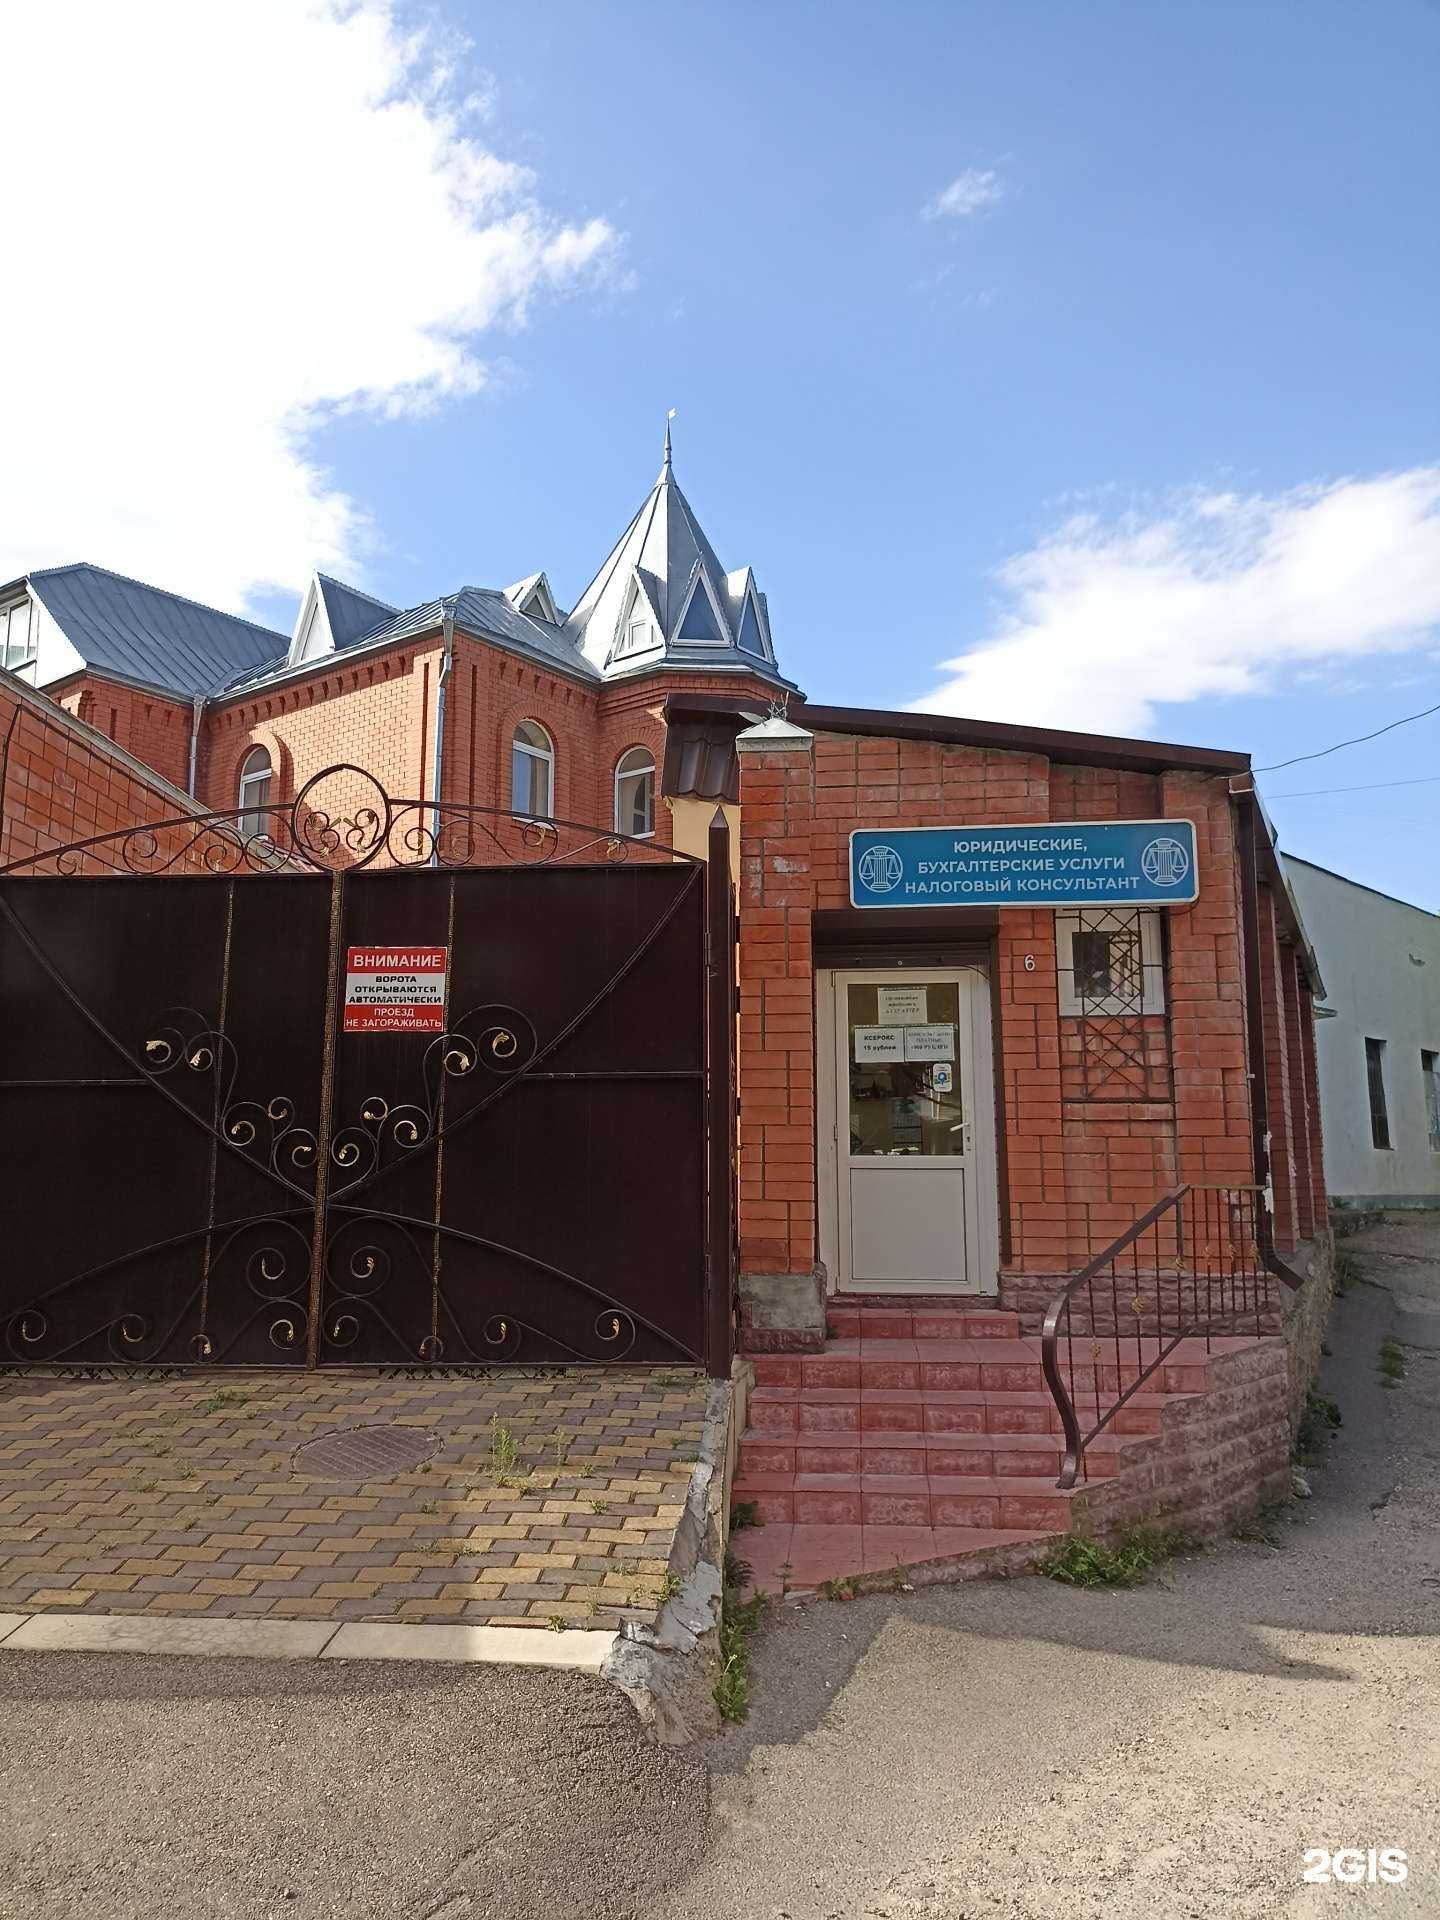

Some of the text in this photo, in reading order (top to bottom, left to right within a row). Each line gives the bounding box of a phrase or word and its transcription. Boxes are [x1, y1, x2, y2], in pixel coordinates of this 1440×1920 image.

[953, 838, 1088, 854] ЮРИДИЧЕСКИЕ,
[917, 857, 1126, 875] БУХГАЛТЕРСКИЕ УСЛУГИ
[905, 876, 1140, 894] НАЛОГОВЫЙ КОНСУЛЬТАНТ
[353, 954, 442, 967] ВНИМАНИЕ
[1024, 954, 1035, 971] 6
[375, 975, 417, 983] ВОРОТА
[349, 996, 442, 1004] АВТОМАТИЧЕСКИ
[374, 1008, 415, 1017] ПРОЕЗД
[346, 1018, 442, 1027] НЕ ЗАГОРАЖИВАТЬ
